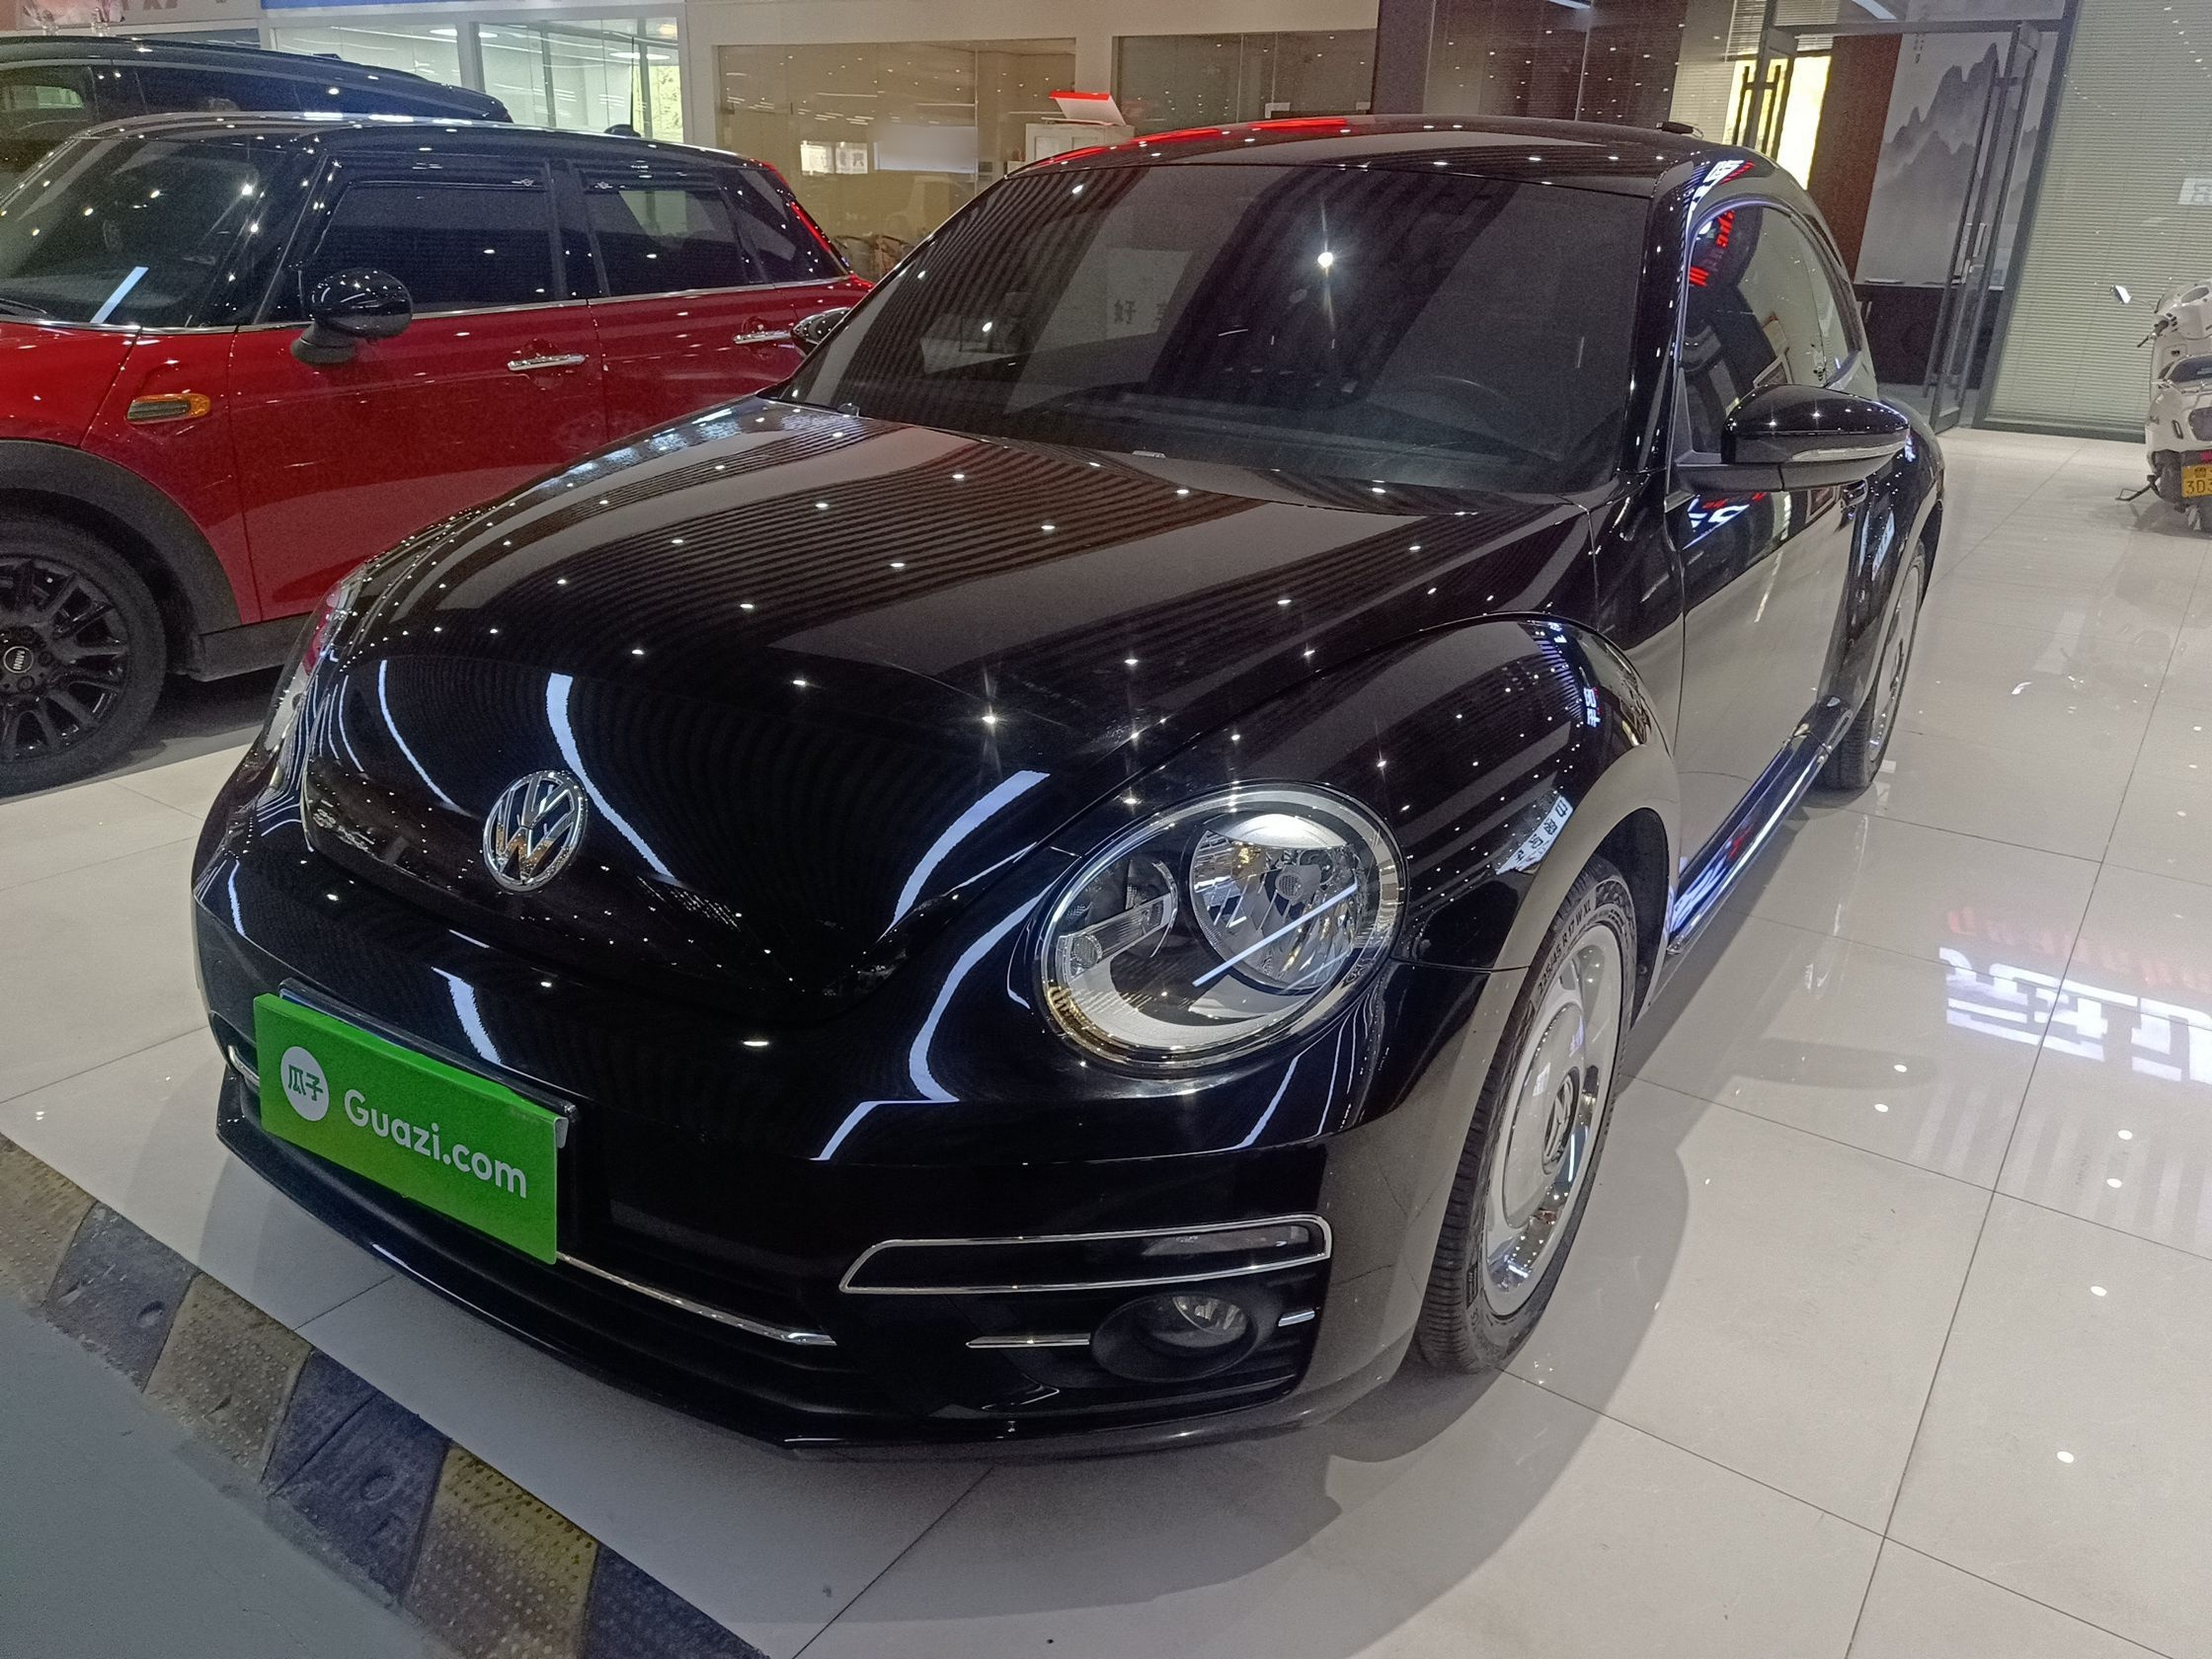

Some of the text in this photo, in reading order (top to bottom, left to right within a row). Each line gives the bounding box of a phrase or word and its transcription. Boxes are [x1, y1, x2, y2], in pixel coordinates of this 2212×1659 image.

[13, 650, 25, 670] MINI
[287, 1063, 324, 1101] 瓜子
[343, 1088, 528, 1199] Guazi.com
